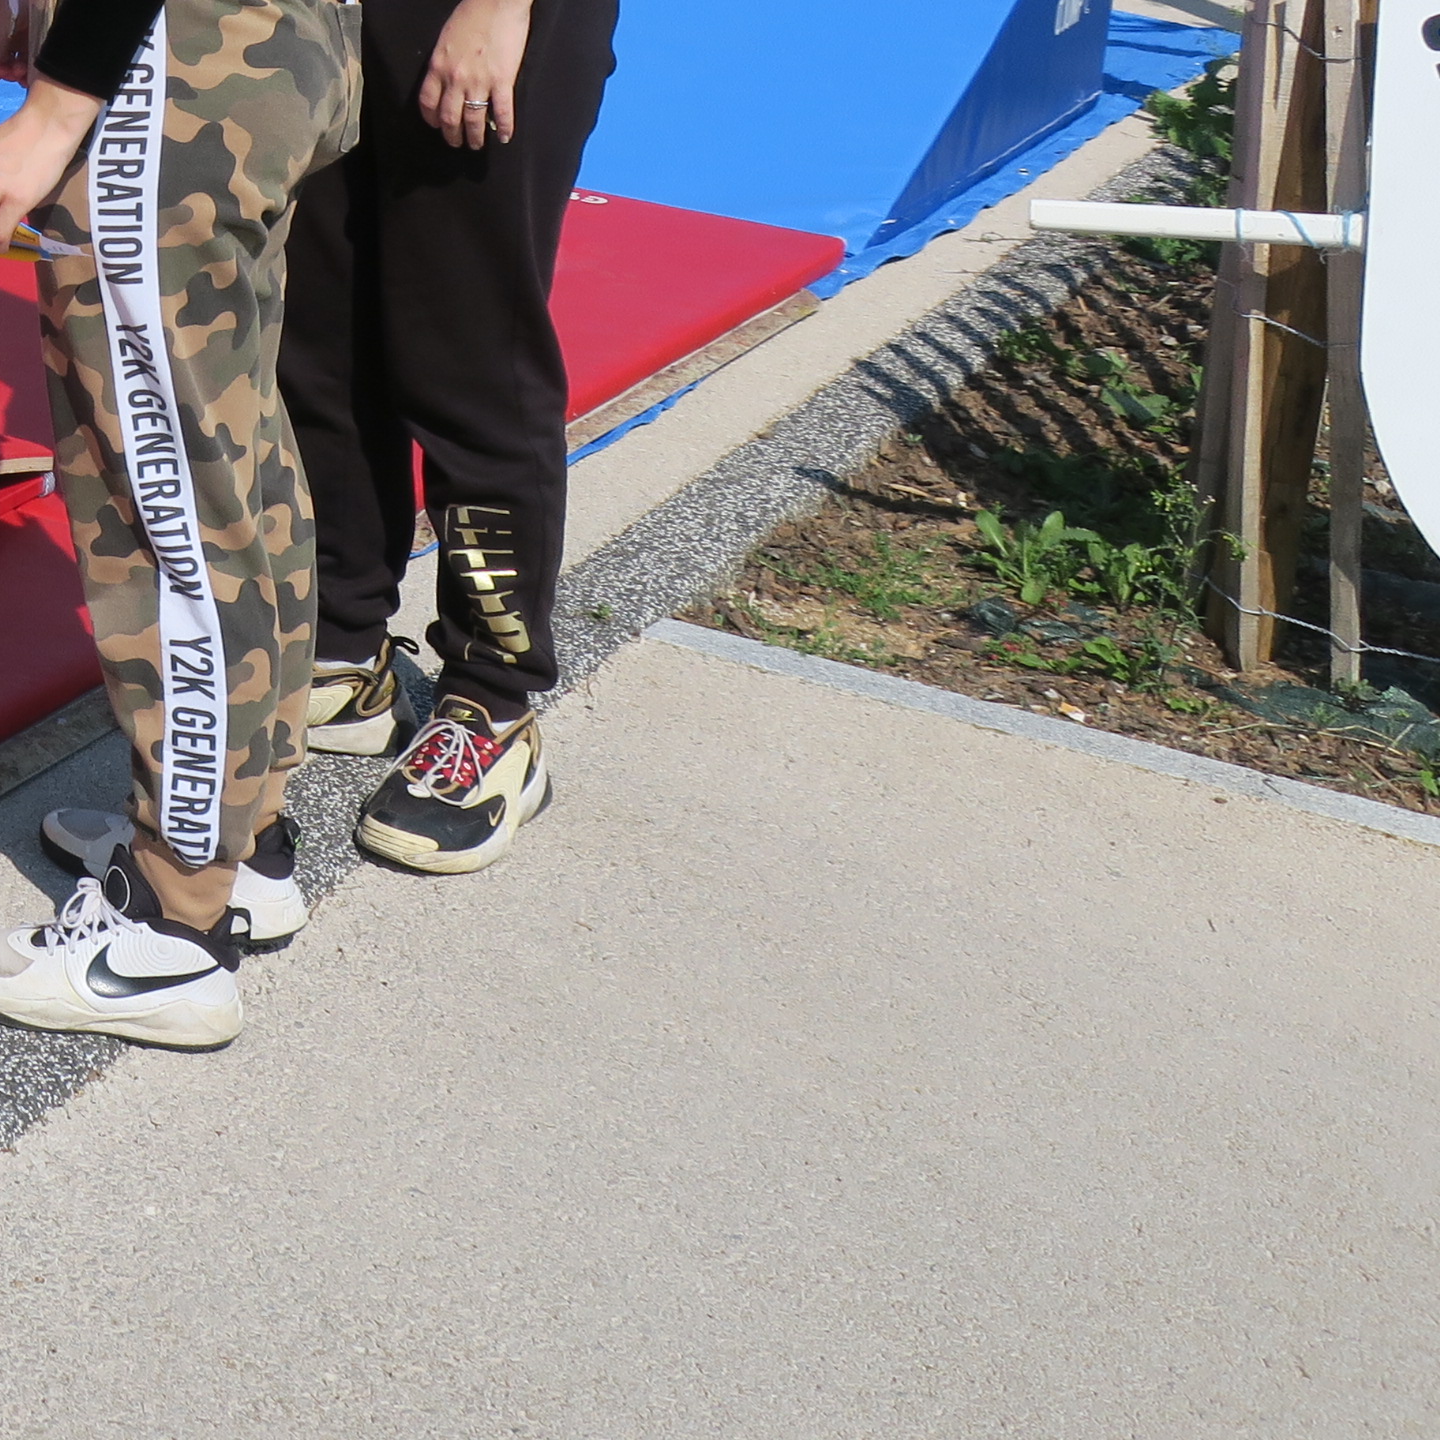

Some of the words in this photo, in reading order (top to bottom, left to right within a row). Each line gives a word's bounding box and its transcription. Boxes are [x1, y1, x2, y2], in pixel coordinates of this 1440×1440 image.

[97, 62, 155, 286] GENERATION
[115, 323, 161, 392] Y2K
[128, 388, 204, 601] GENERATION
[169, 635, 216, 701] Y2K
